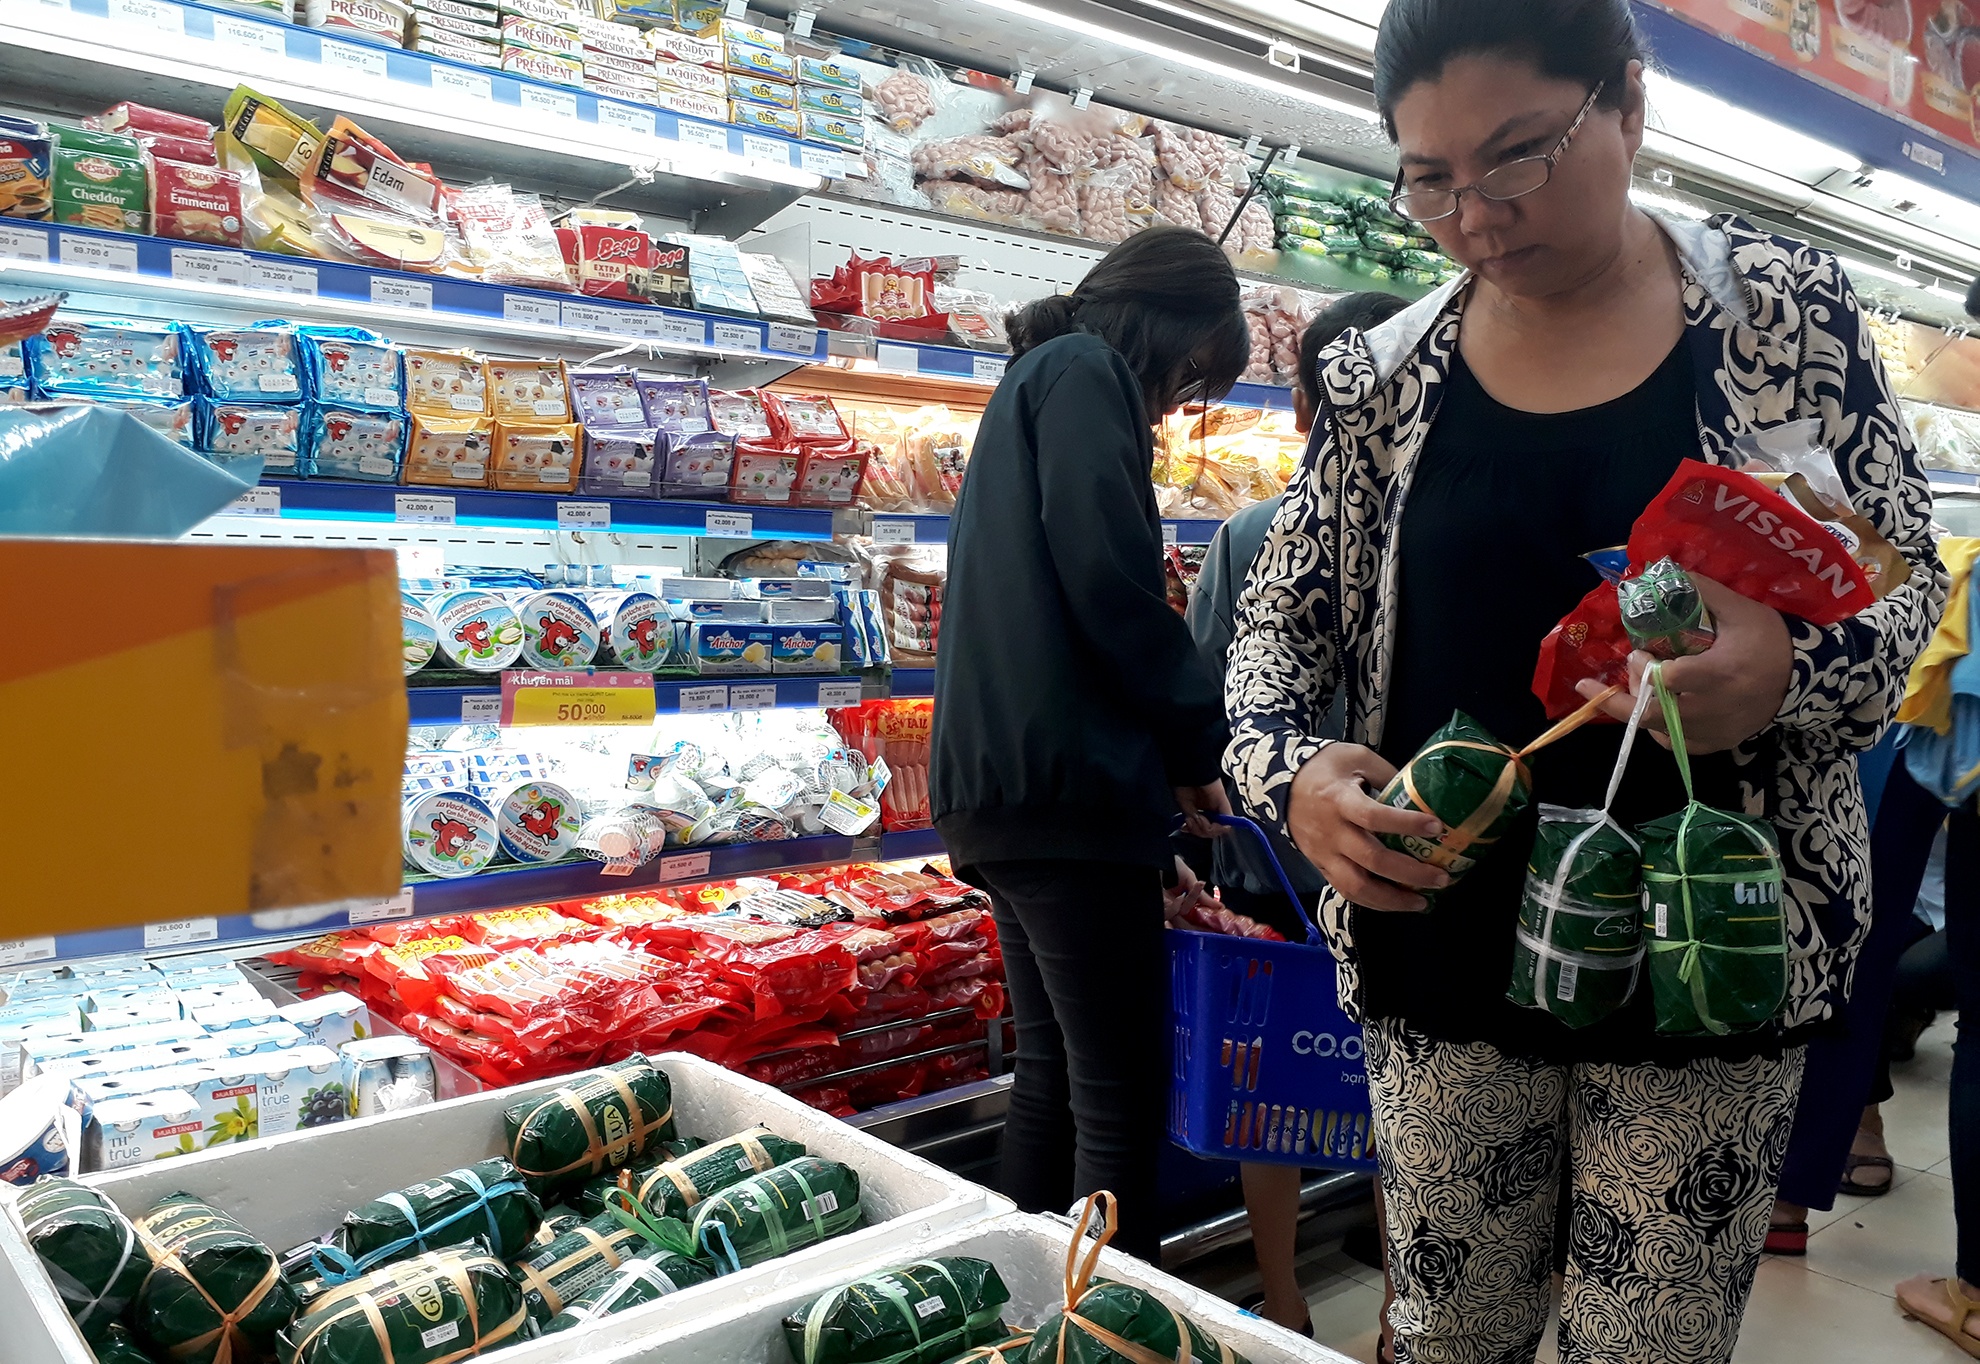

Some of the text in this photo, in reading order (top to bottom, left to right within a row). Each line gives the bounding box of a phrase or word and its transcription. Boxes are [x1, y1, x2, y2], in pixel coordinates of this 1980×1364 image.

[371, 166, 405, 193] Edam
[71, 187, 126, 206] Cheddar
[170, 193, 230, 212] Emmental
[598, 236, 641, 260] Bega
[593, 263, 621, 274] EXTRA
[406, 503, 427, 511] 42.000
[1713, 484, 1857, 601] VISSAN
[451, 601, 478, 618] Laughing
[710, 634, 745, 649] Anchor
[783, 634, 816, 649] Anchor
[555, 676, 573, 686] mãi
[446, 802, 469, 813] Vache
[468, 810, 481, 819] qui
[1403, 835, 1432, 859] GIÒ
[216, 1091, 229, 1099] MUA
[262, 1085, 278, 1096] TH
[262, 1093, 290, 1107] true
[157, 1128, 171, 1137] MUA
[109, 1137, 128, 1147] TH
[109, 1145, 141, 1159] true
[412, 1285, 441, 1317] GIÒ
